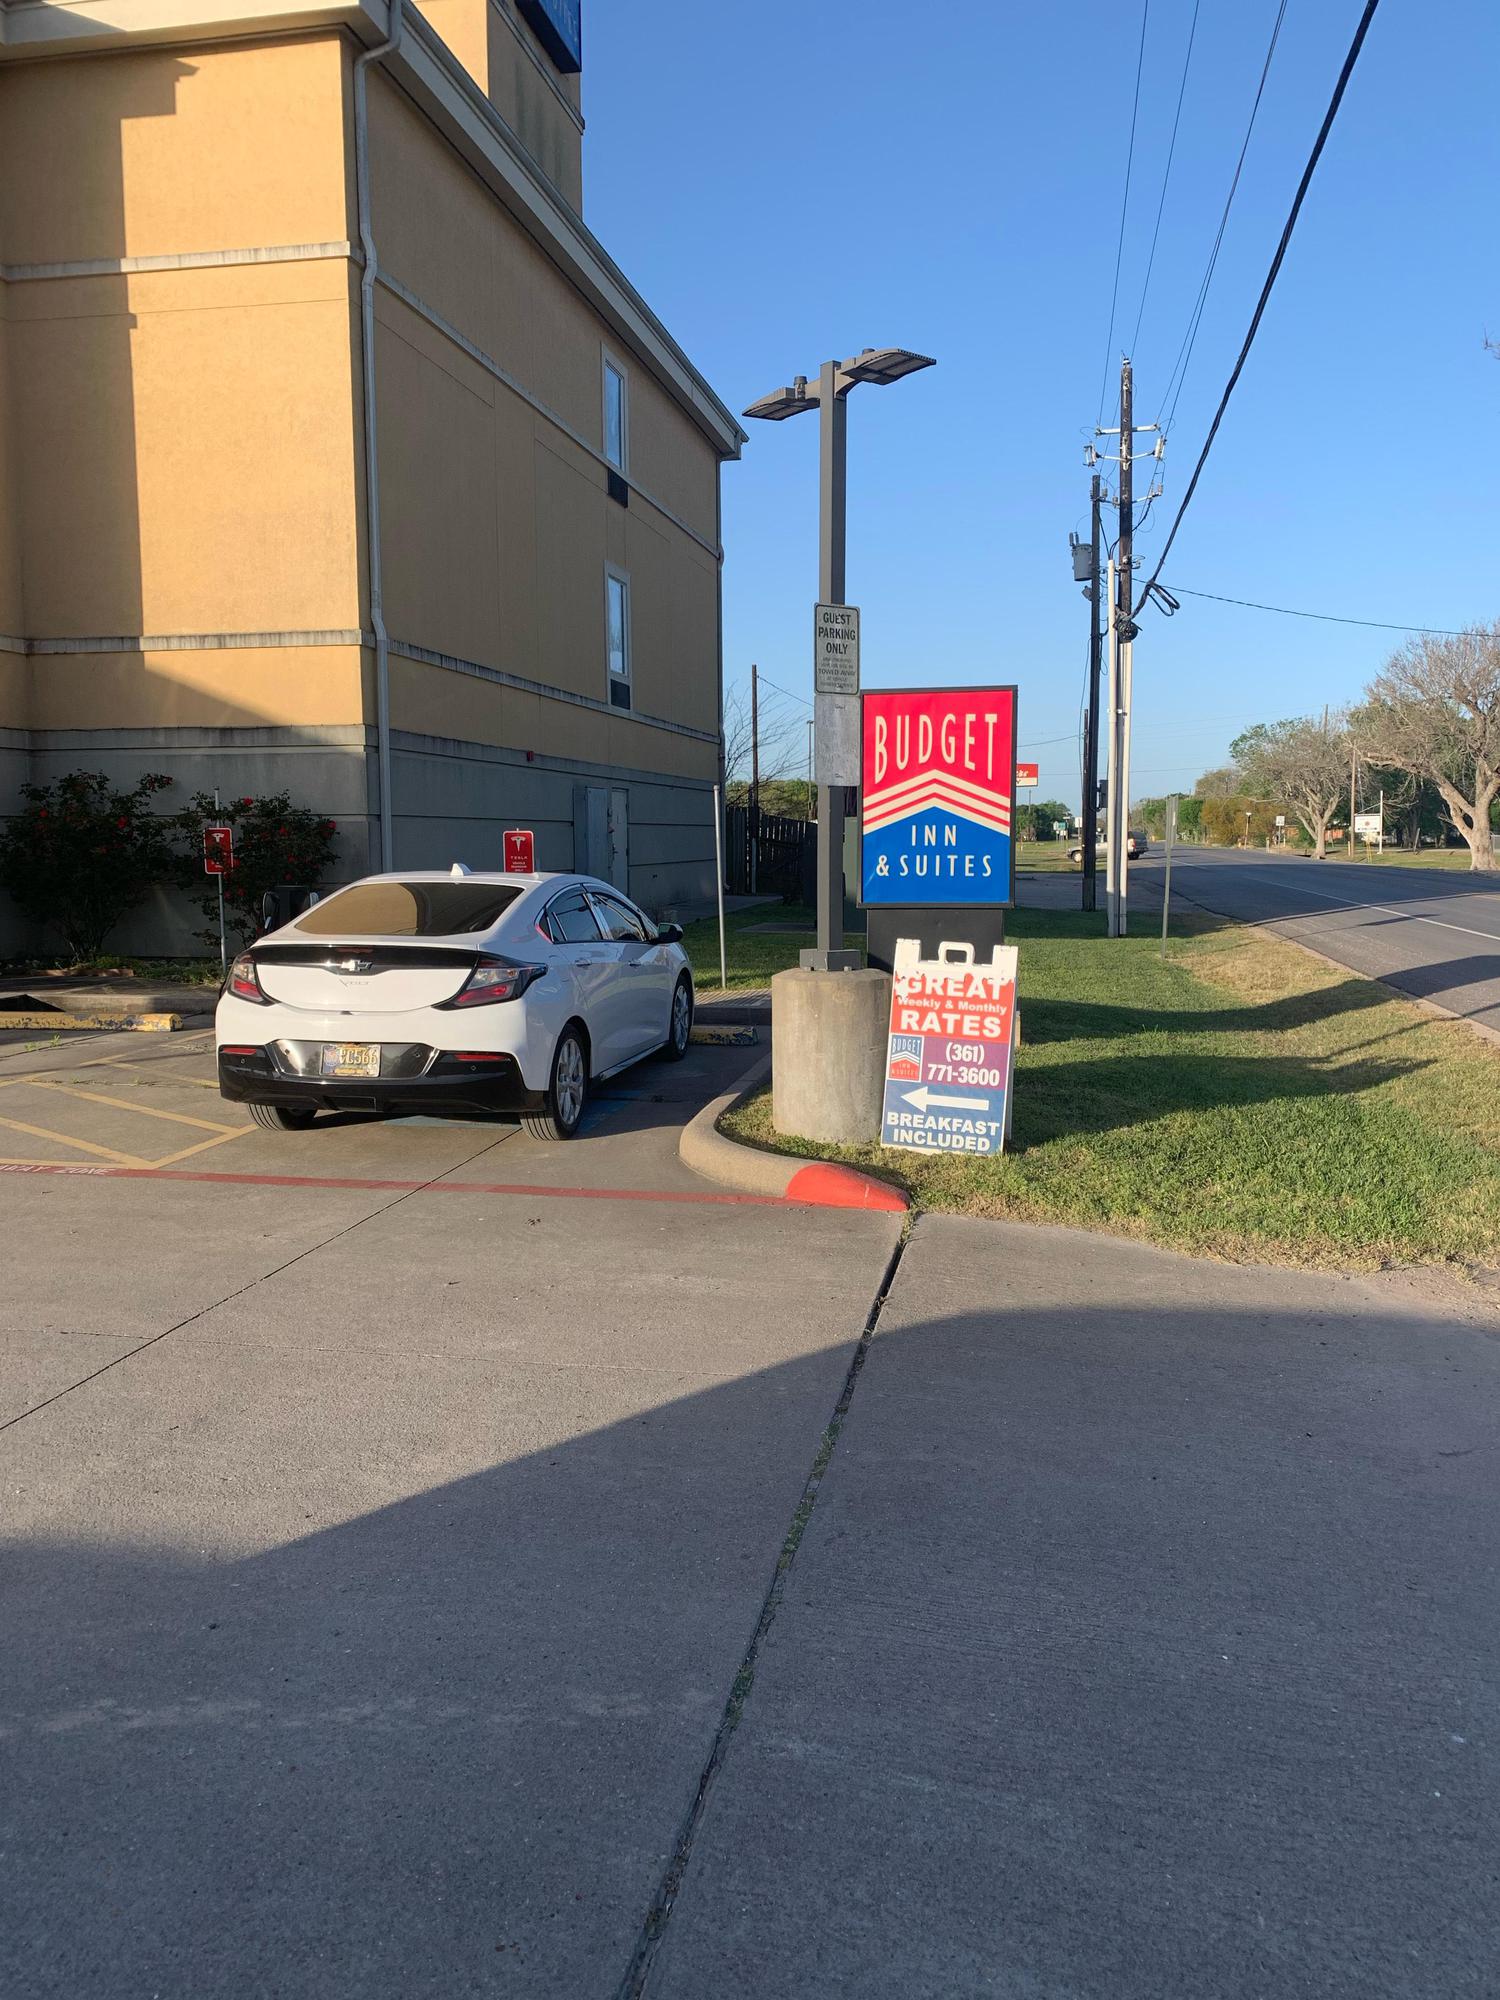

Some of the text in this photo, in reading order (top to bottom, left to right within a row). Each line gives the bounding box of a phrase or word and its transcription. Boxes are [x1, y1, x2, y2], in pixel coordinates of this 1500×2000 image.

[823, 612, 852, 625] GUEST
[818, 627, 856, 641] PARKING
[826, 642, 848, 655] ONLY
[874, 713, 998, 785] BUDGET
[911, 824, 957, 847] INN
[875, 854, 992, 877] & SUITES
[904, 972, 1006, 1001] GREAT
[897, 996, 1007, 1015] Weekly & Monthly
[900, 1010, 1001, 1038] RATES
[892, 1037, 921, 1055] BUDGET
[945, 1041, 985, 1065] (361)
[927, 1063, 1000, 1087] 771-3600
[886, 1111, 1000, 1137] BREAKFAST
[893, 1128, 991, 1152] INCLUDED
[54, 1167, 116, 1175] ZONE
